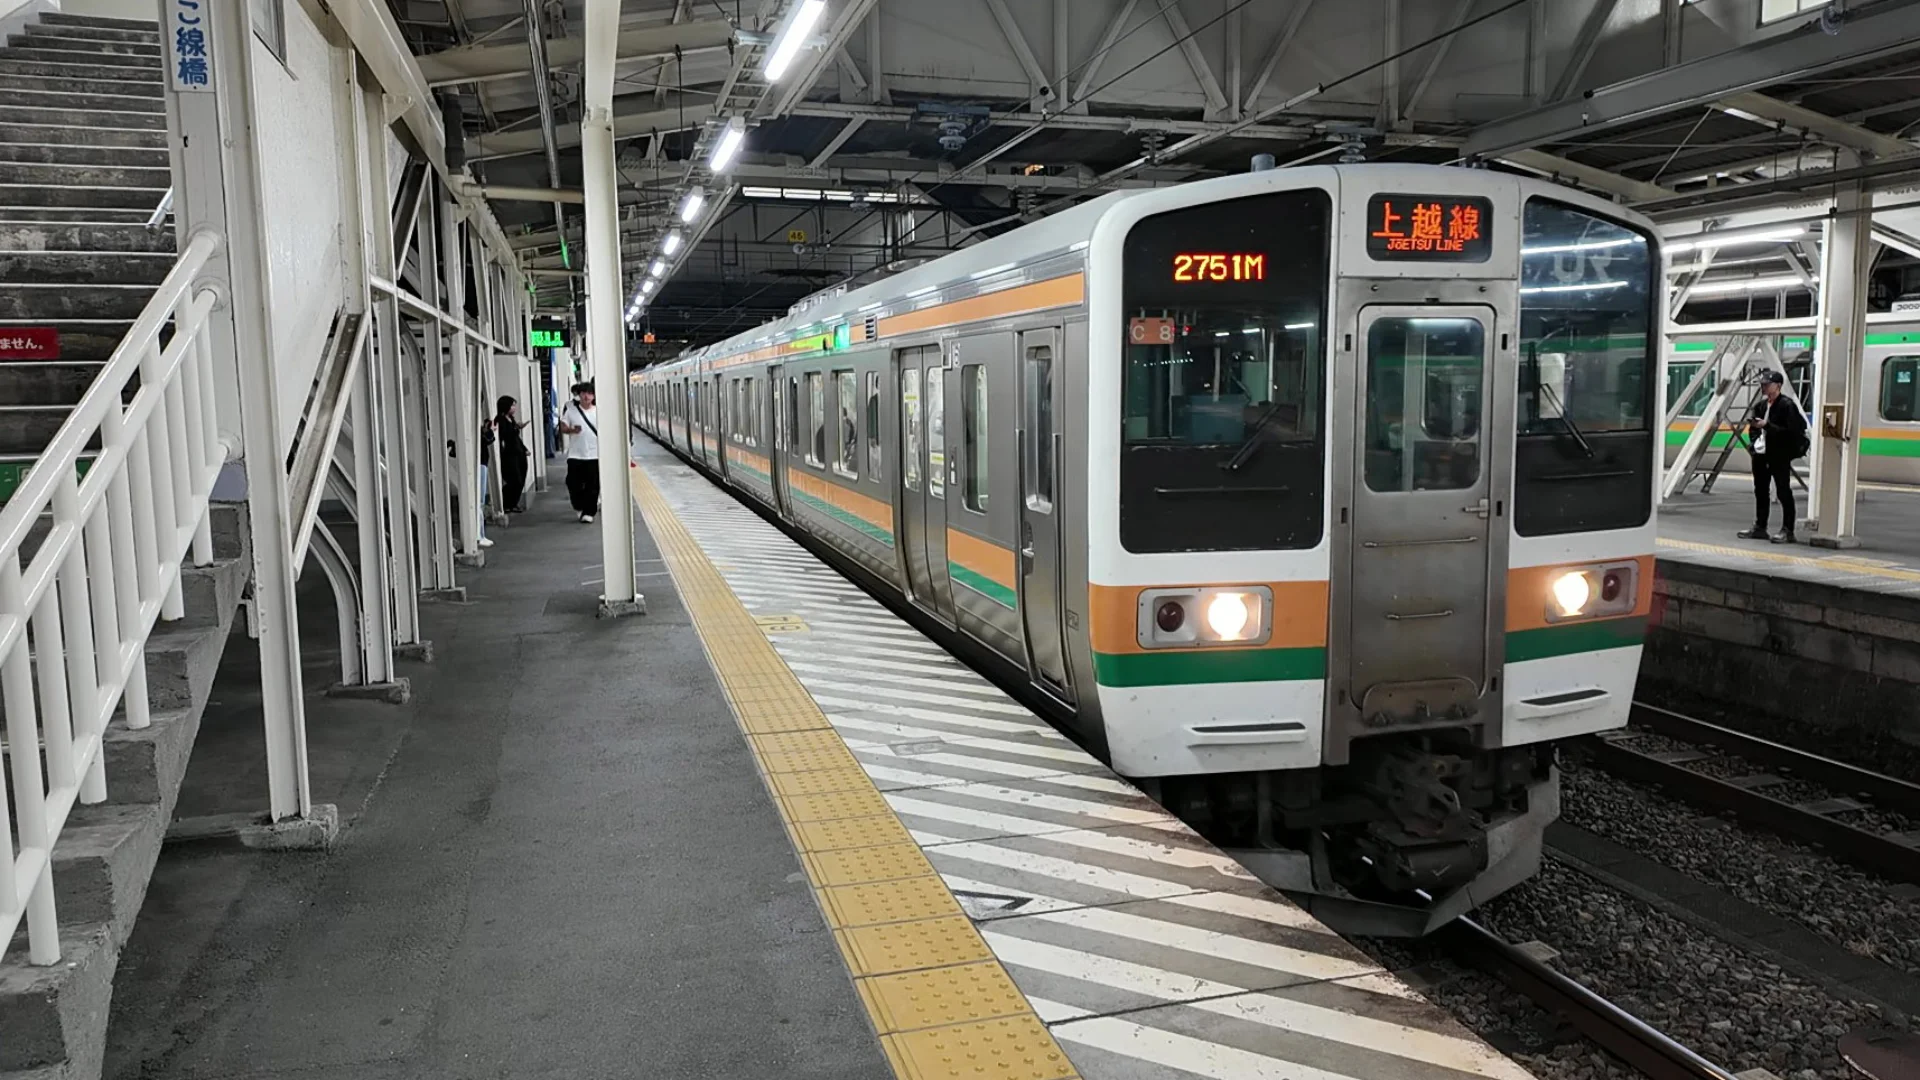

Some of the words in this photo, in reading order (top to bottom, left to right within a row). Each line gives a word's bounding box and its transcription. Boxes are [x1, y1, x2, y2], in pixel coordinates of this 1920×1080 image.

[176, 0, 208, 85] こ線橋
[1372, 202, 1480, 240] 上越線
[1436, 239, 1464, 251] LINE
[1174, 254, 1263, 281] 2751M
[0, 337, 44, 350] ません。
